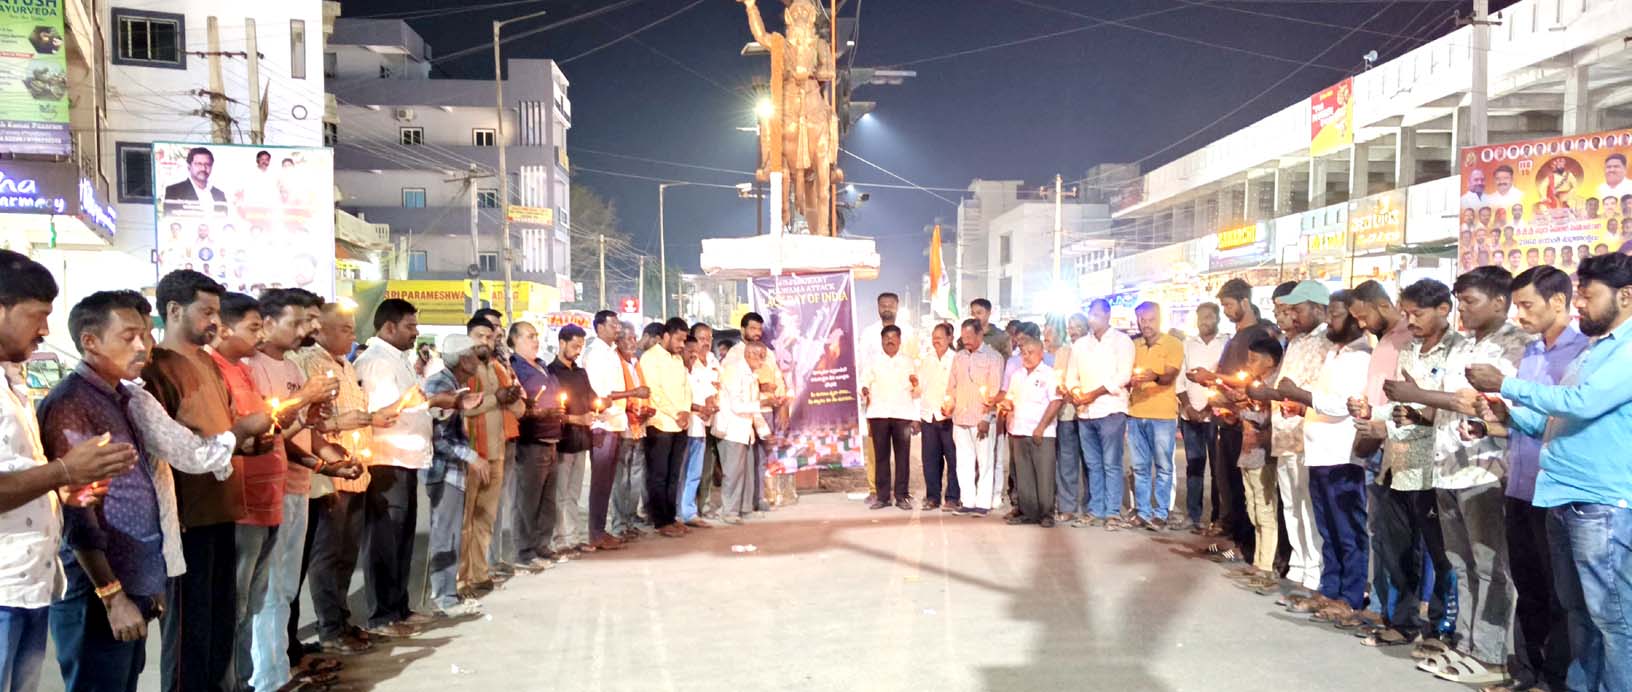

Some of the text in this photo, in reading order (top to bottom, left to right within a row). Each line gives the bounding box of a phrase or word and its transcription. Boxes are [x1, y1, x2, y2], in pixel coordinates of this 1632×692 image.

[0, 0, 57, 8] USH
[806, 283, 835, 292] ATTACK
[384, 290, 402, 300] SRI
[807, 293, 820, 304] OF
[822, 290, 848, 303] INDIA
